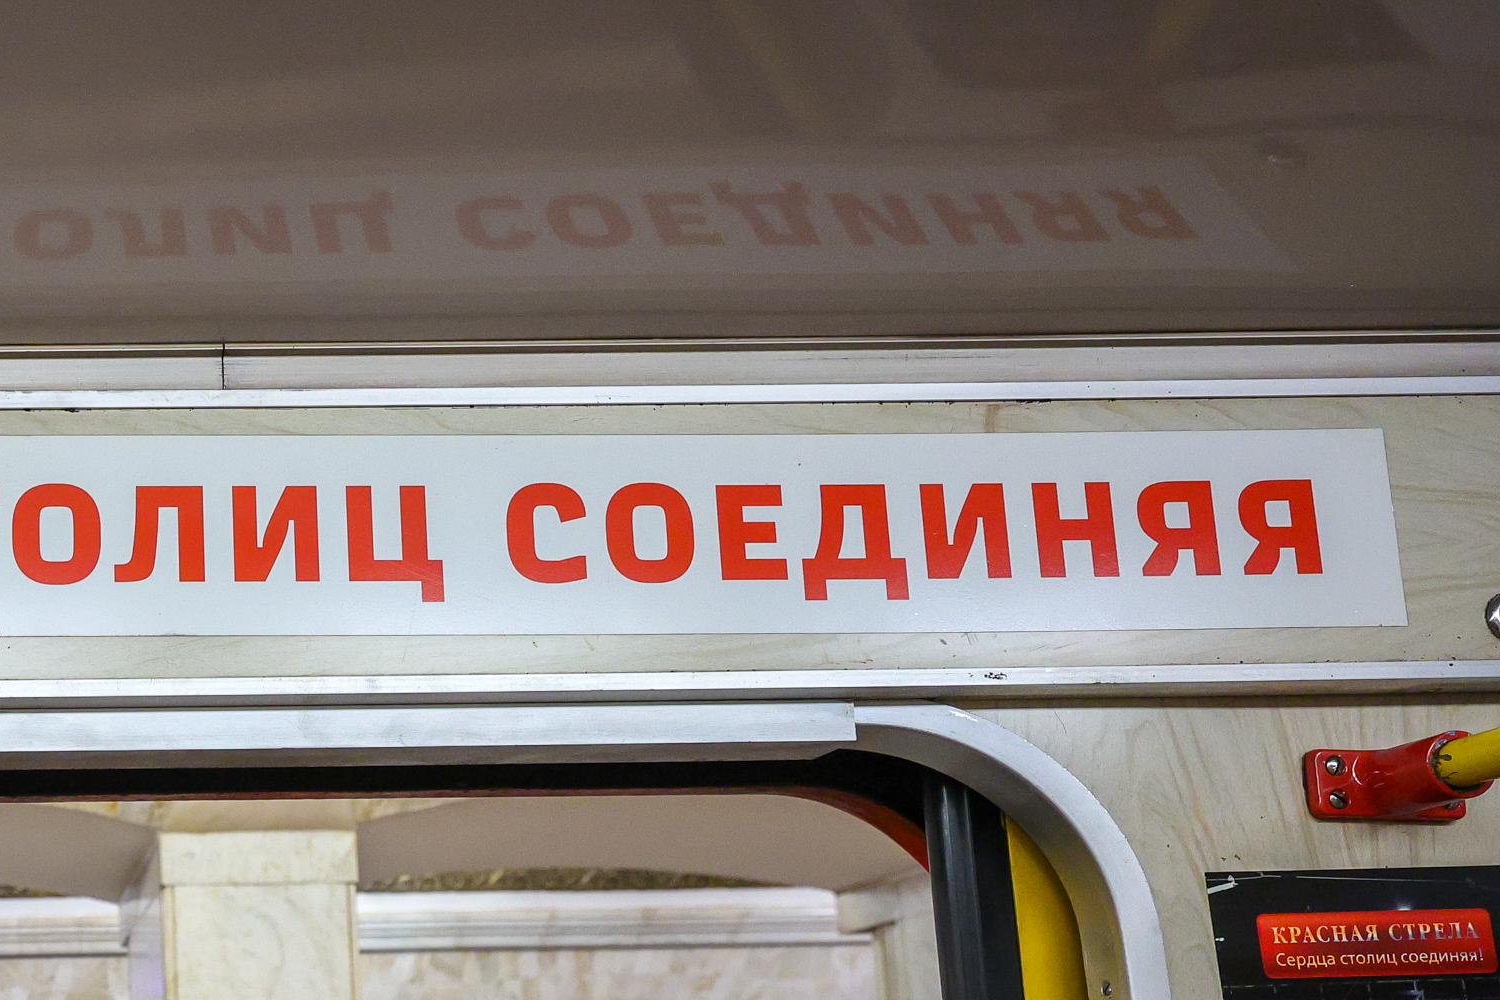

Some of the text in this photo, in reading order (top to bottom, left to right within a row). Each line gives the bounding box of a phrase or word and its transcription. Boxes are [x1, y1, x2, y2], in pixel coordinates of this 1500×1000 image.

[506, 480, 1323, 601] СОЕДИНЯЯ
[1271, 922, 1480, 944] КРАСНАЯ СТРЕЛА
[1276, 948, 1485, 970] Сердца столиц соединяя!
